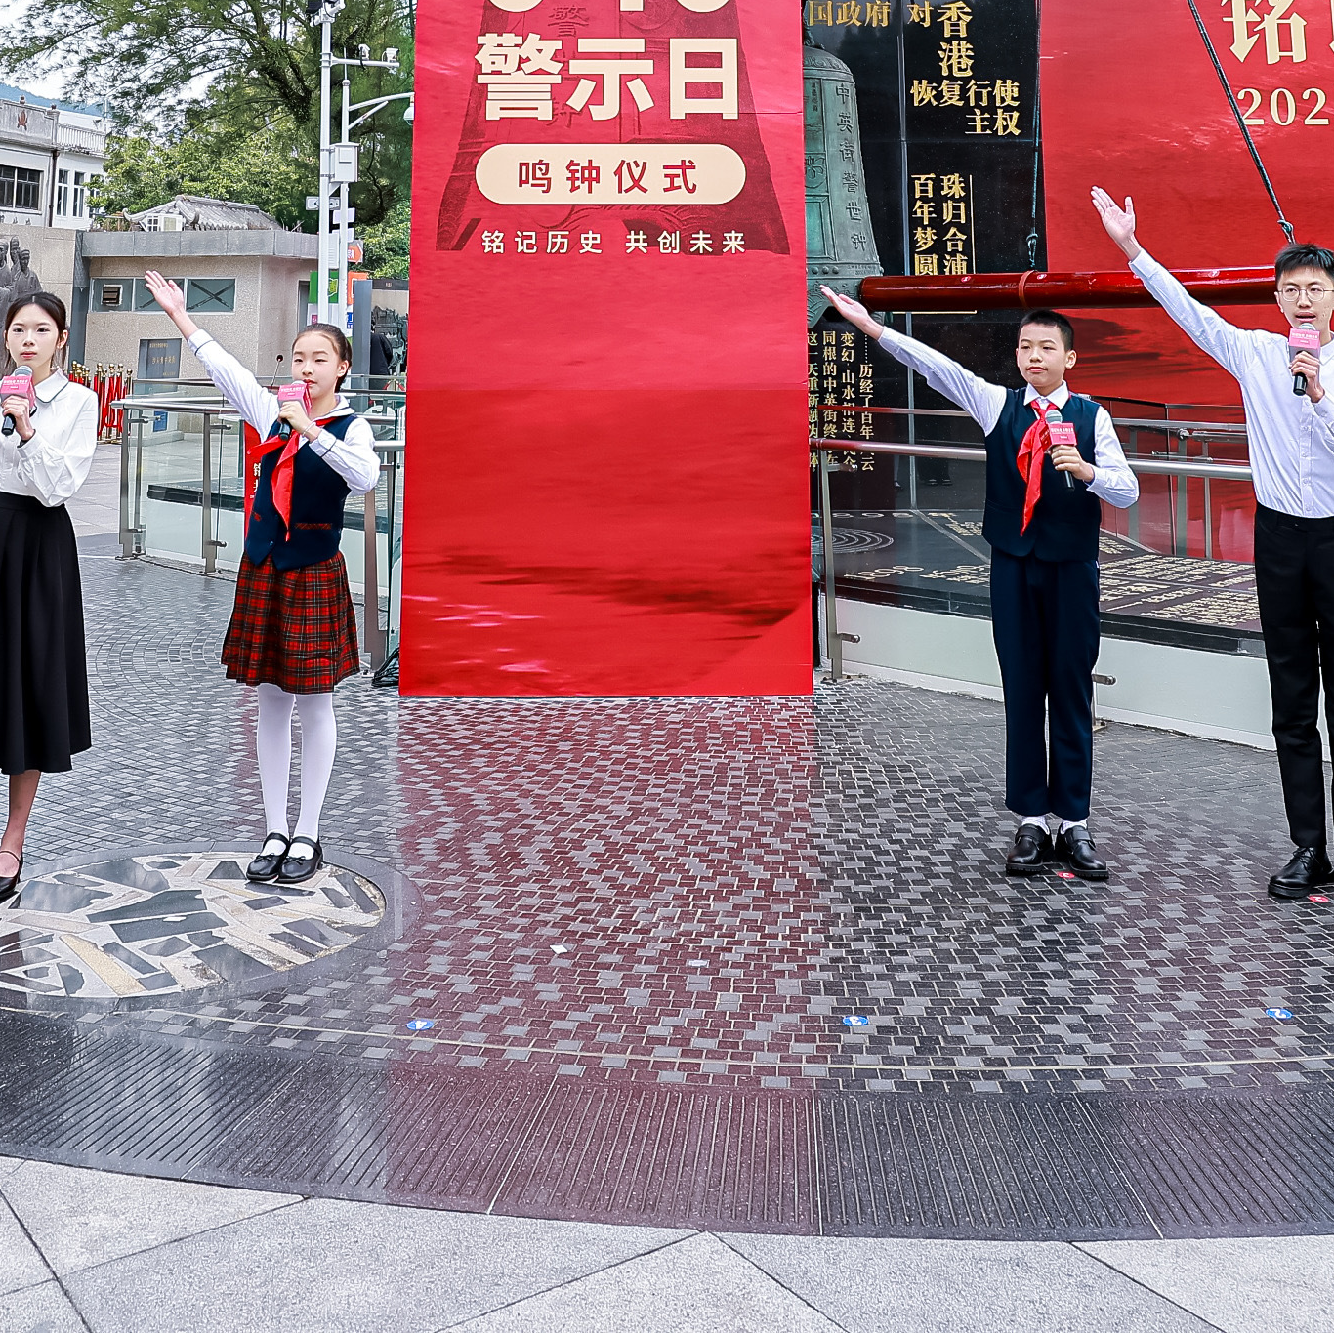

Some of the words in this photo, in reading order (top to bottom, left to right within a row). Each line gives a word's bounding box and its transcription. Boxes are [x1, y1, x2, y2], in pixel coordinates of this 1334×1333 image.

[808, 0, 891, 28] 国政府
[475, 33, 739, 122] 警示日
[909, 79, 1021, 107] 恢复行使
[964, 108, 1022, 136] 主权
[517, 158, 698, 196] 鸣钟仪式
[480, 229, 604, 255] 铭记历史
[624, 229, 746, 255] 共创未来
[910, 172, 939, 276] 百年梦圆
[939, 172, 969, 275] 珠归合浦
[822, 330, 838, 466] 同根的中英街终在
